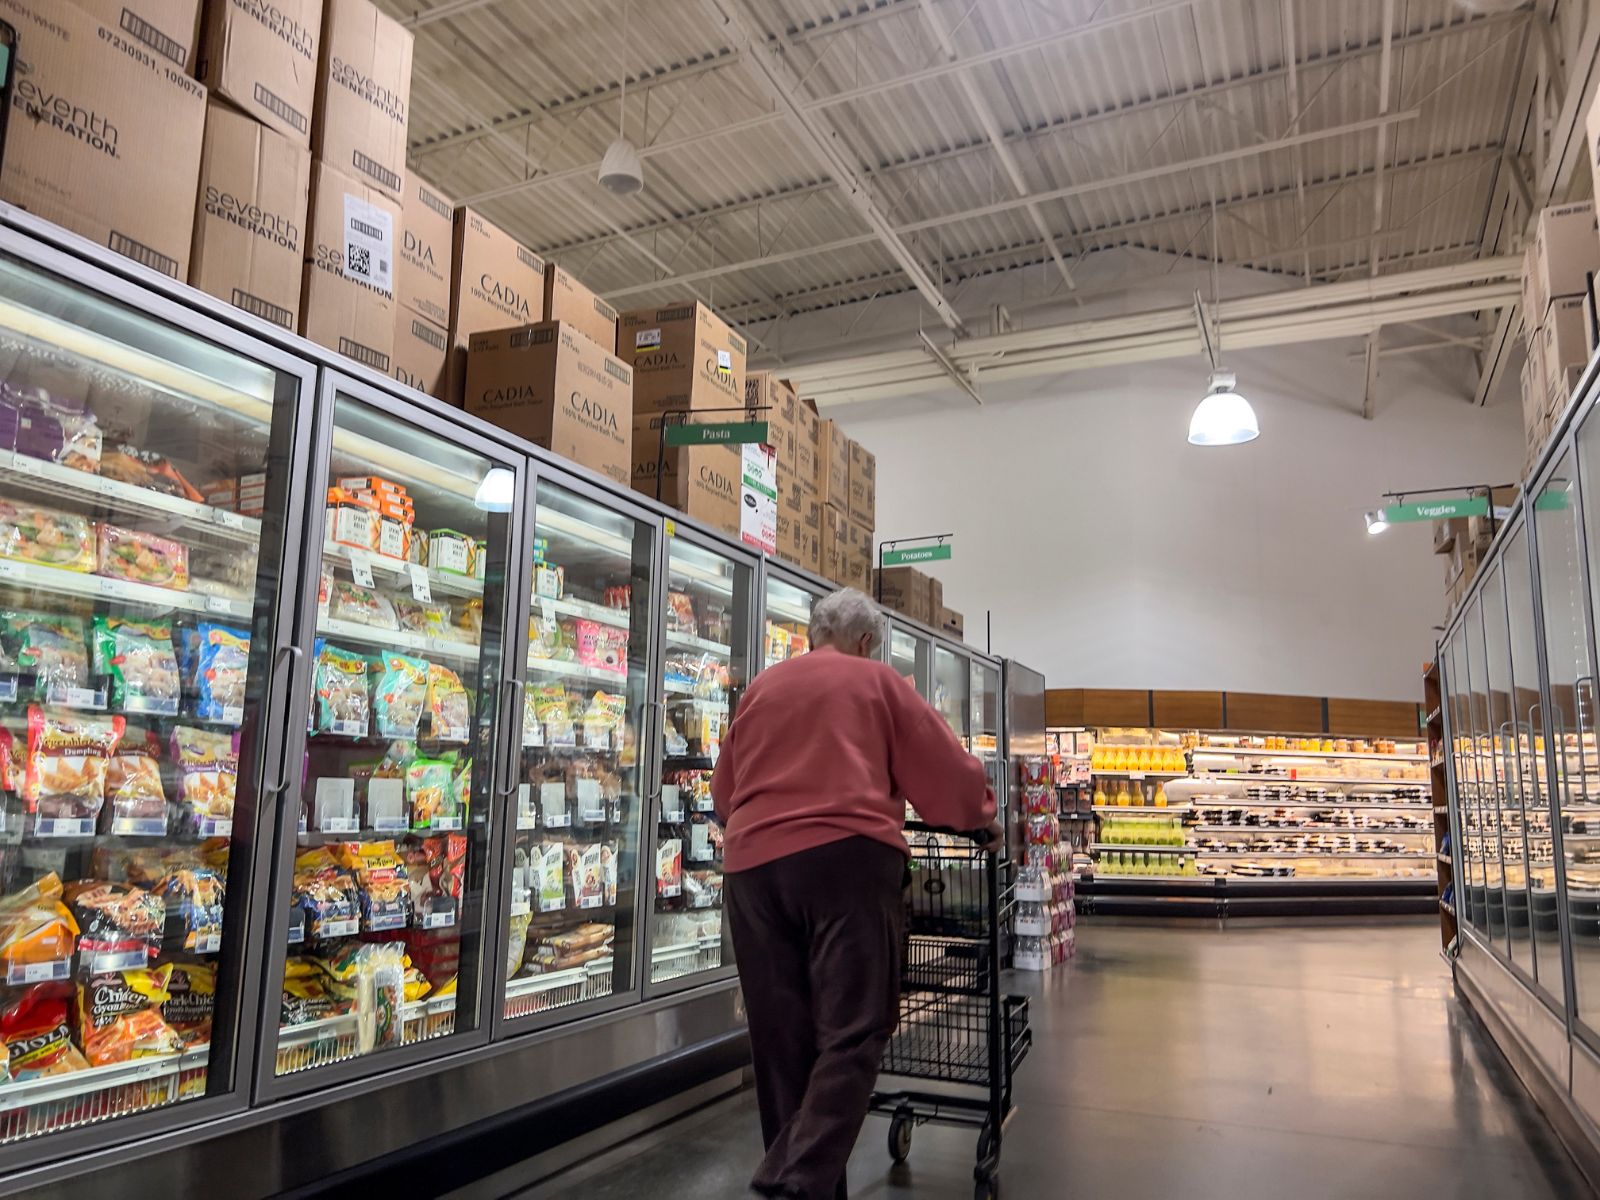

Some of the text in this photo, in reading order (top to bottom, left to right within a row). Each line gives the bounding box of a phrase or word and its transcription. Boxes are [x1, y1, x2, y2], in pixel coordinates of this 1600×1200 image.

[163, 67, 204, 101] 100074
[331, 70, 404, 125] GENERATION
[332, 57, 405, 113] seventh
[12, 93, 116, 157] ENERATION
[13, 79, 118, 145] eventh
[205, 203, 298, 253] GENERATION
[206, 185, 299, 241] seventh
[403, 229, 434, 266] DIA
[480, 273, 530, 317] CADIA
[633, 352, 678, 368] CADIA
[395, 366, 425, 393] DIA
[483, 384, 535, 403] CADIA
[571, 391, 618, 431] CADIA
[703, 428, 731, 440] Pasta
[700, 464, 734, 497] CADIA
[1416, 505, 1456, 517] Veggies
[901, 551, 933, 561] Potatoes
[64, 748, 102, 757] Dumpling
